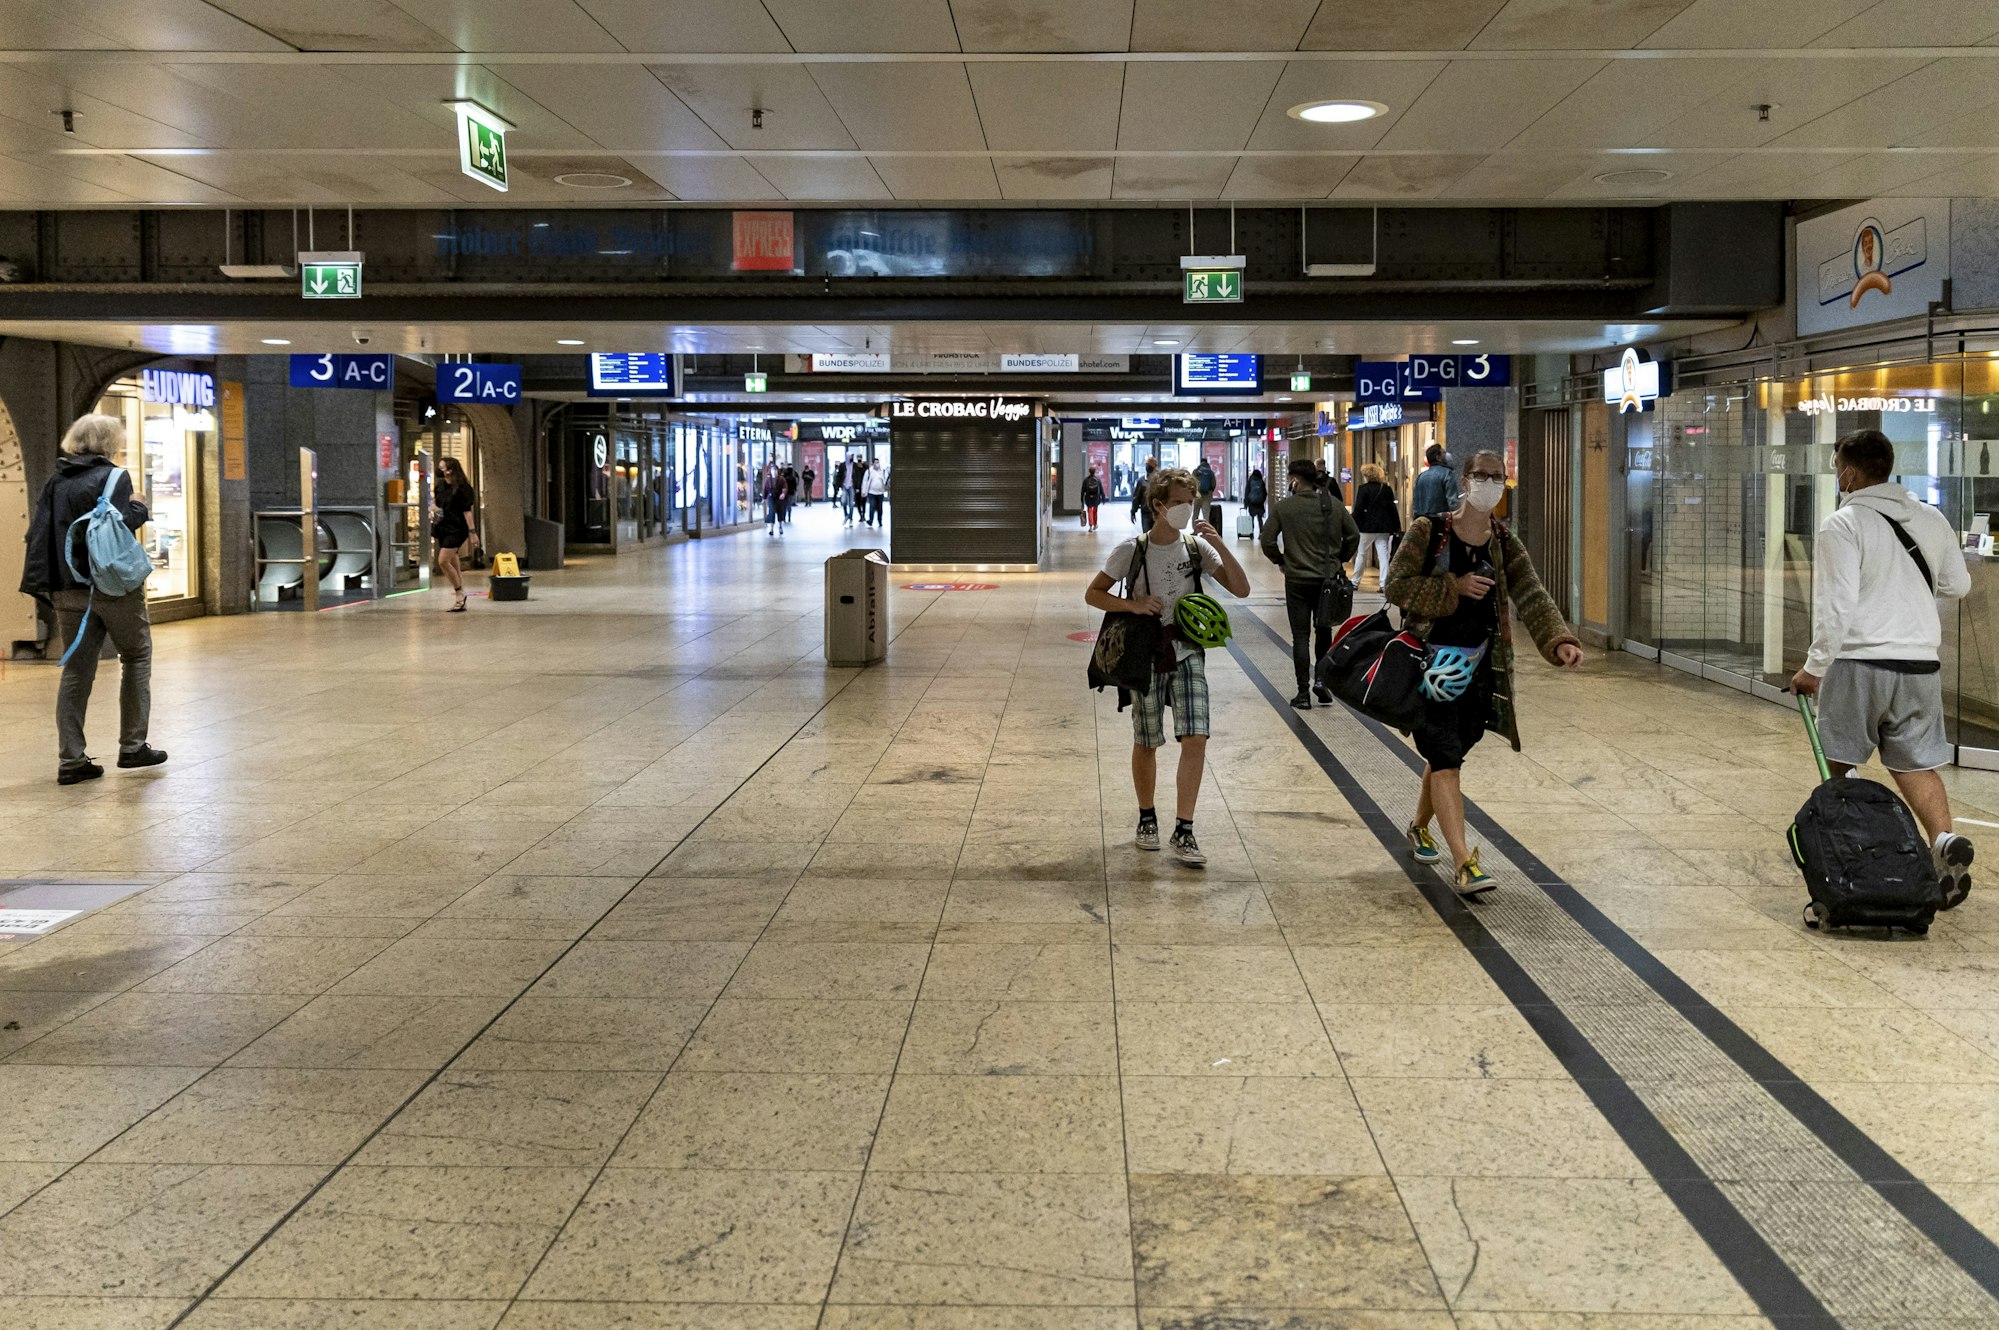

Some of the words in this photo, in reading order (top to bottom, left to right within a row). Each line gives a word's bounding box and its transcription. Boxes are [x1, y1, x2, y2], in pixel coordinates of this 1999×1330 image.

[735, 219, 791, 258] EXPRESS
[310, 353, 334, 381] 3
[344, 360, 387, 383] A-C
[819, 359, 885, 368] BUNDESPOLIZEI
[1007, 359, 1073, 368] BUNDESPOLIZEI
[1414, 359, 1455, 379] D-G
[1467, 354, 1491, 380] 3
[142, 368, 215, 407] LUDWIG
[454, 367, 474, 398] 2
[482, 379, 518, 399] A-C
[1360, 379, 1396, 396] D-G
[893, 402, 915, 417] LE
[917, 402, 987, 417] CROBAG
[989, 397, 1030, 421] Veggie
[739, 426, 772, 442] ETERNA
[821, 426, 856, 439] WDR
[868, 586, 876, 643] Abfall
